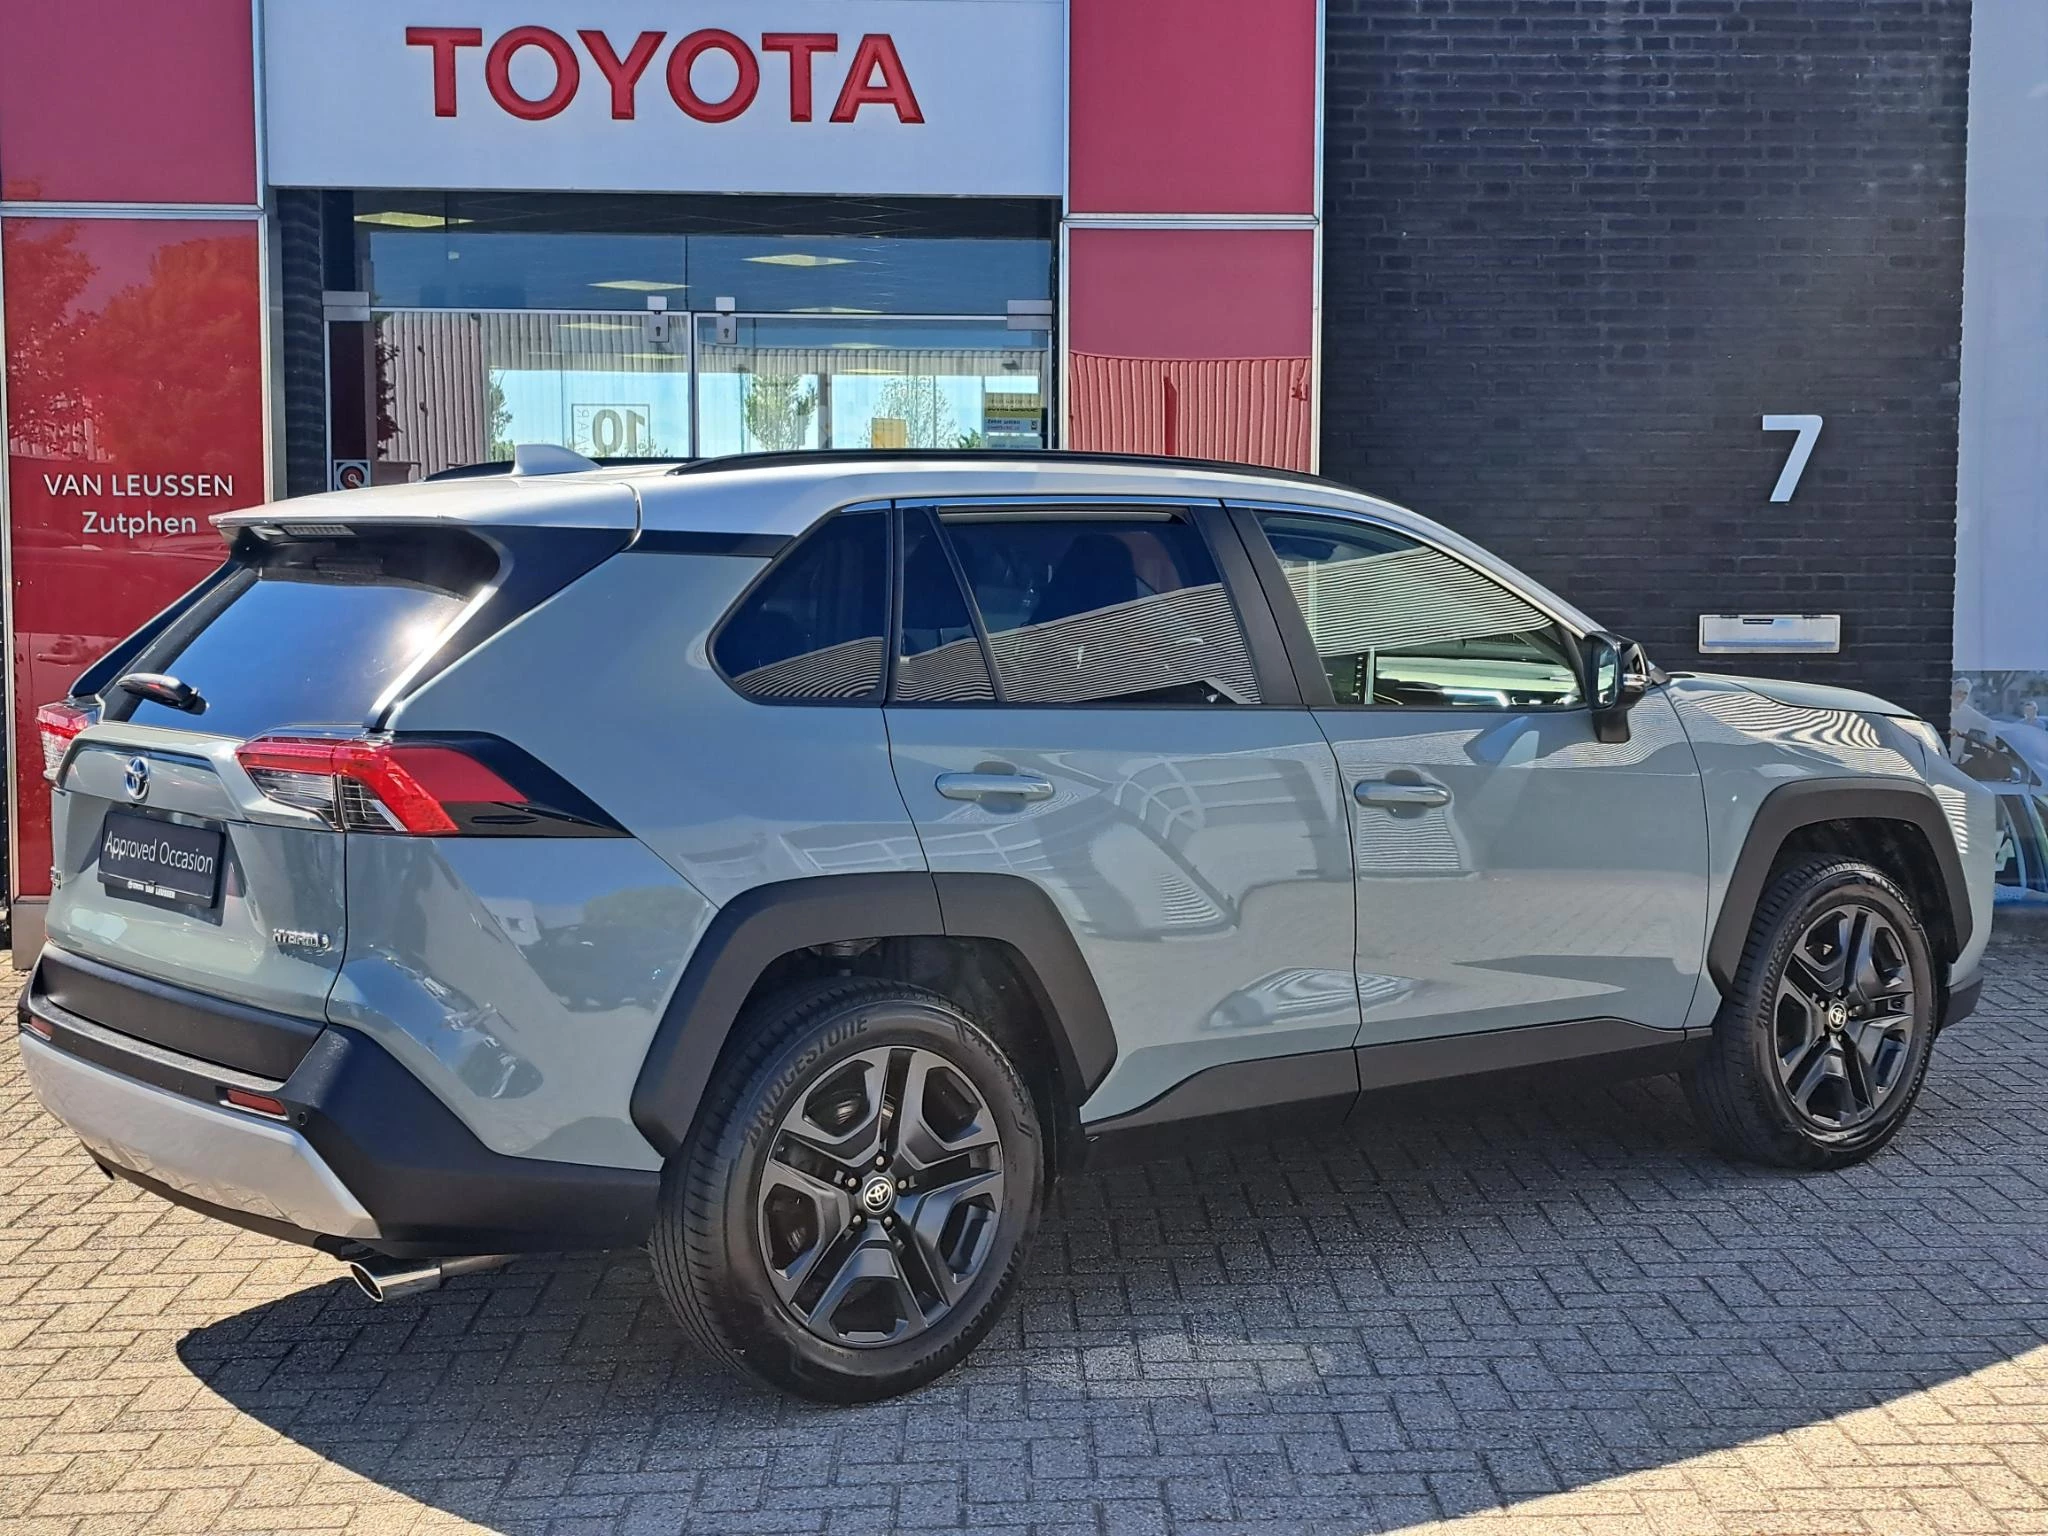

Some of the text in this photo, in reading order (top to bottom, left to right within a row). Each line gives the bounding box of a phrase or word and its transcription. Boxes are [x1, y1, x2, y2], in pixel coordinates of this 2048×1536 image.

[405, 25, 926, 125] TOYOTA
[1762, 414, 1823, 502] 7
[43, 473, 234, 497] VAN LEUSSEN
[81, 510, 197, 539] Zutphen
[104, 830, 214, 875] Approved Occasion
